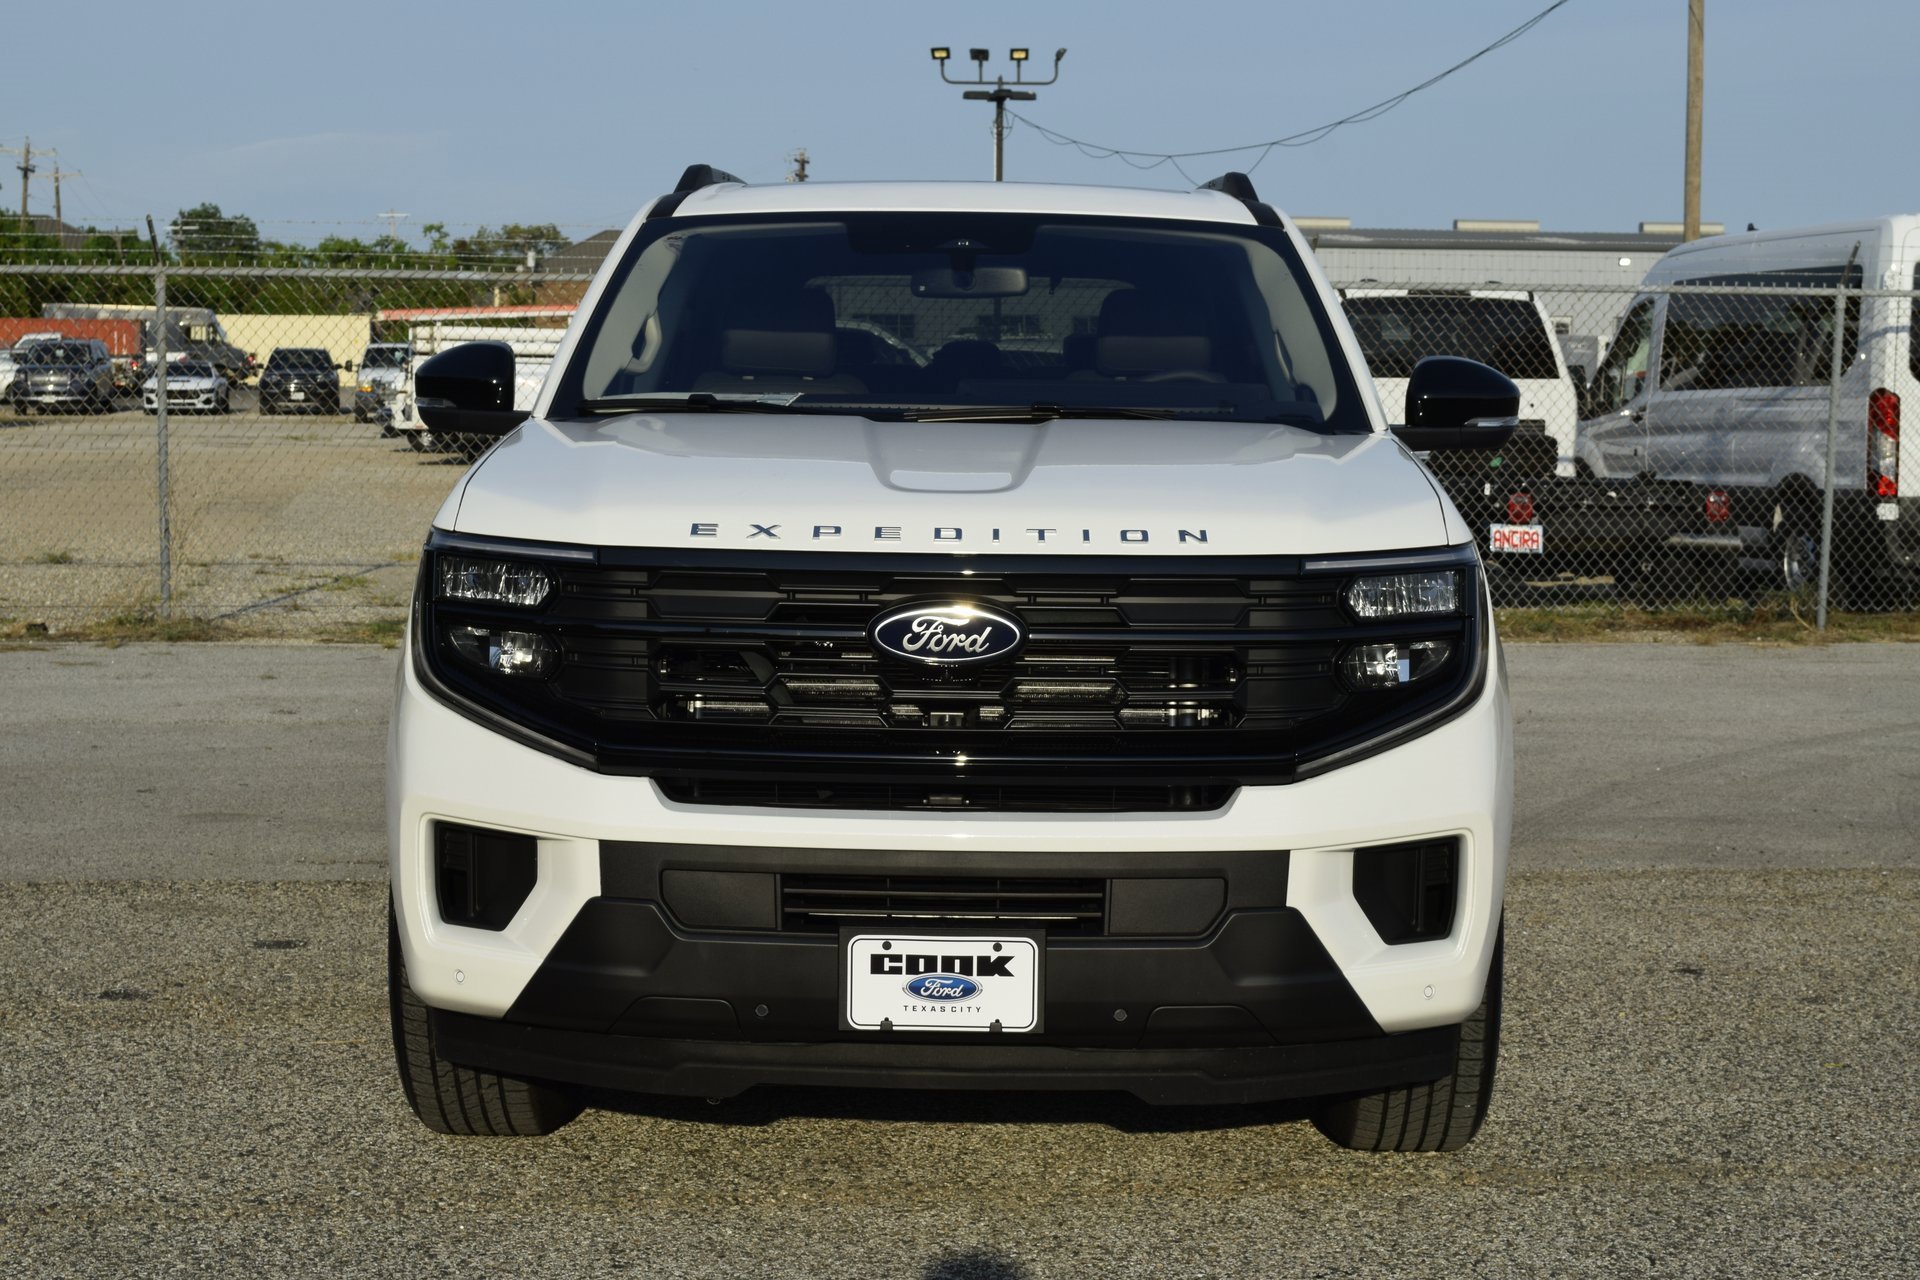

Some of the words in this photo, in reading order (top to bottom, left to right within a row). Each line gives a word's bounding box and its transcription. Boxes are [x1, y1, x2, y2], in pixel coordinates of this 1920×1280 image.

[689, 522, 1209, 545] EXPEDITION
[1493, 530, 1539, 549] ANCIRA
[902, 615, 992, 653] Ford
[870, 953, 1015, 977] COOK
[920, 978, 964, 998] Ford
[903, 1005, 946, 1013] TEXAS
